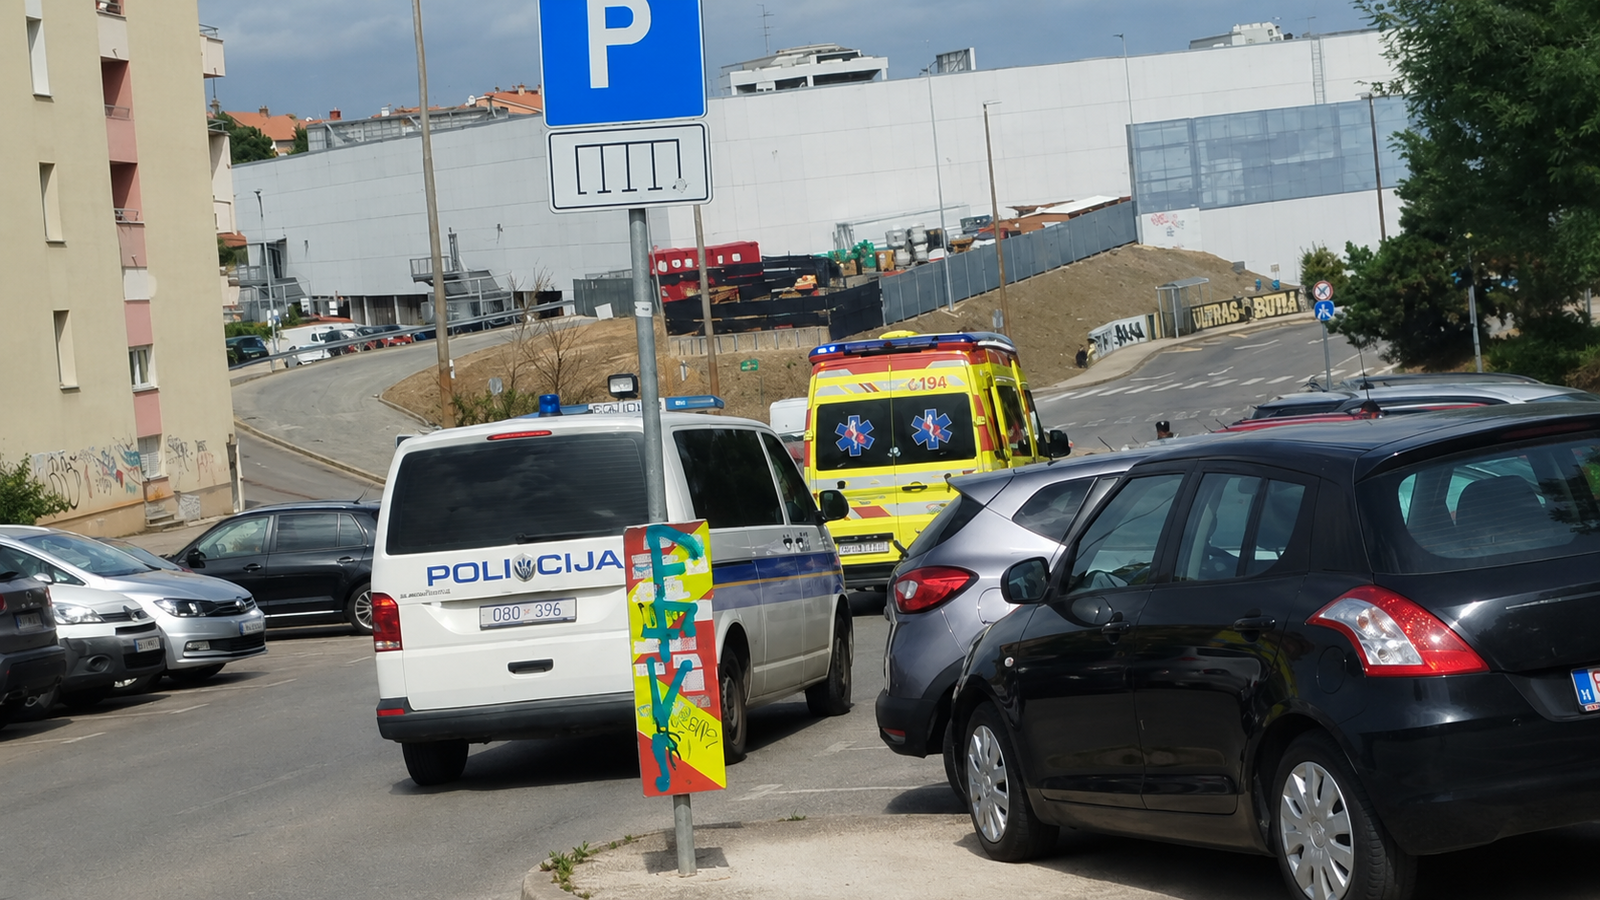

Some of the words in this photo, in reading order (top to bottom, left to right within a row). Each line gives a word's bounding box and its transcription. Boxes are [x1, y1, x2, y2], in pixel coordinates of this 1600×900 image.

[587, 0, 652, 89] P
[919, 375, 948, 391] 194
[492, 605, 521, 623] 080
[535, 602, 562, 618] 396
